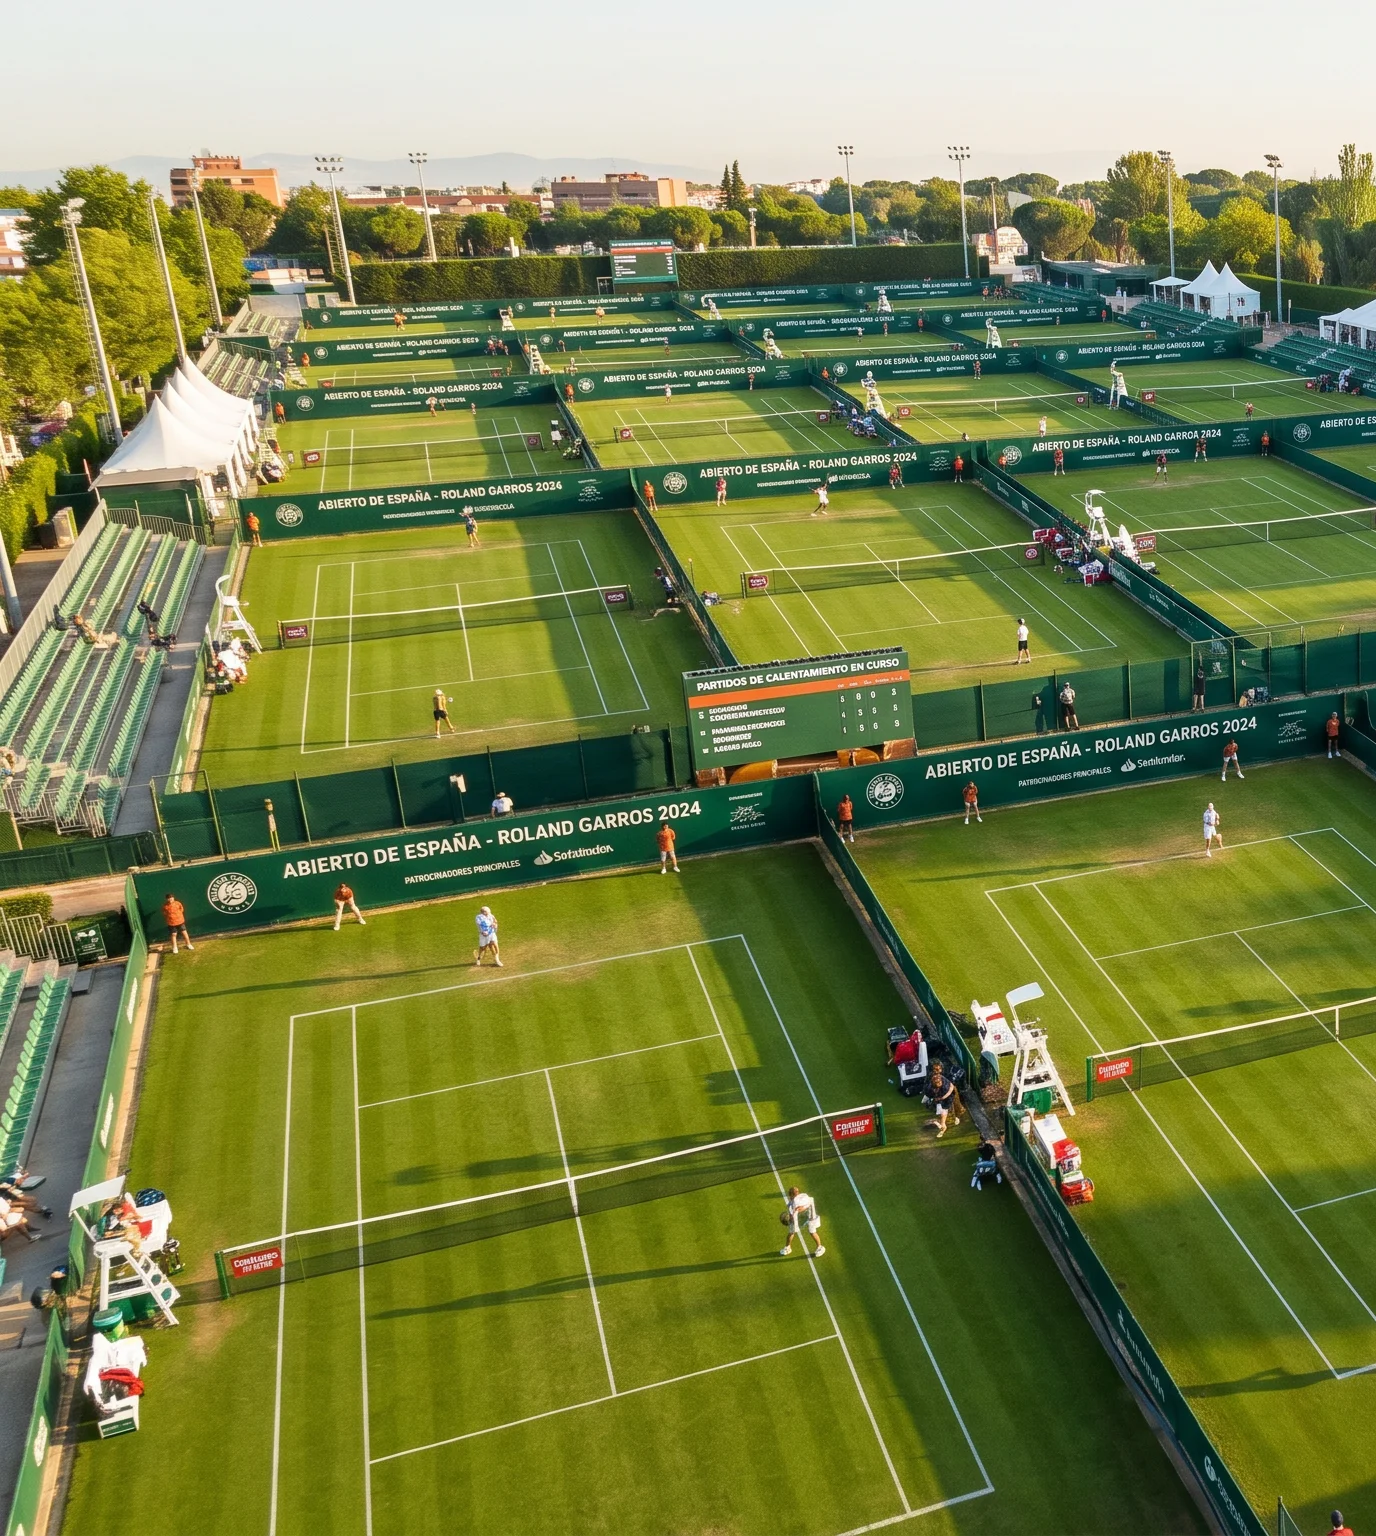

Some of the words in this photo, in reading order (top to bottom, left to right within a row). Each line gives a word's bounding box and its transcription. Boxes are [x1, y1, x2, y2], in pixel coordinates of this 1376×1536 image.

[324, 391, 359, 400] ABIERTO
[481, 382, 503, 390] 2024
[603, 374, 635, 382] ABIERTO
[1320, 417, 1353, 428] ABIERTO
[1354, 416, 1365, 425] DE
[1031, 440, 1070, 452] ABIERTO
[1072, 439, 1084, 448] DE
[1127, 433, 1162, 443] ROLAND
[699, 465, 742, 478] ABIERTO
[745, 464, 759, 474] DE
[760, 458, 799, 473] ESPAÑA
[808, 457, 848, 469] ROLAND
[850, 453, 891, 465] GARROS
[893, 451, 917, 462] 2024
[318, 496, 366, 510] ABIERTO
[368, 495, 385, 506] DE
[386, 489, 431, 504] ESPAÑA
[440, 486, 485, 499] ROLAND
[488, 482, 533, 495] GARROS
[696, 676, 747, 691] PARTIDOS
[749, 674, 764, 684] DE
[765, 664, 848, 682] CALENTAMIENTO
[850, 662, 864, 671] EN
[866, 657, 899, 669] CURSO
[925, 756, 992, 779] ABIERTO
[997, 752, 1017, 768] DE
[1021, 740, 1081, 764] ESPAÑA
[1095, 732, 1155, 753] ROLAND
[1159, 721, 1218, 743] GARROS
[1222, 716, 1257, 733] 2024
[283, 851, 368, 878] ABIERTO
[373, 846, 400, 864] DE
[404, 831, 481, 859] ESPAÑA
[497, 820, 573, 845] ROLAND
[578, 807, 653, 832] GARROS
[657, 800, 701, 820] 2024
